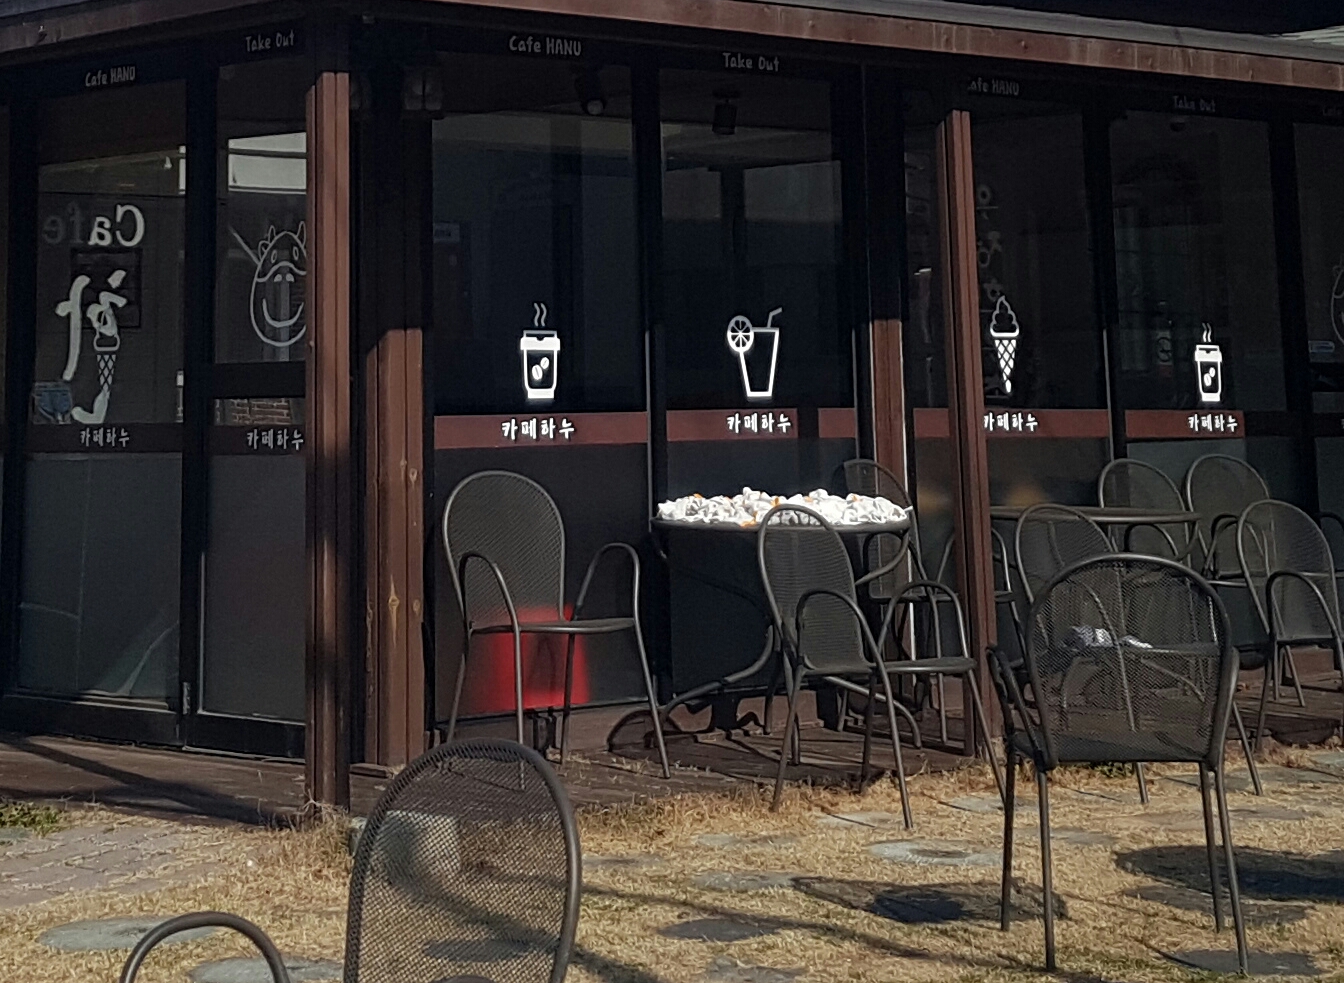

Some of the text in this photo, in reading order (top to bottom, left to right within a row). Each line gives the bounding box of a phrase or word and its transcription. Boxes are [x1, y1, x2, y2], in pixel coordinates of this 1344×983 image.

[246, 28, 295, 52] Take Out
[509, 35, 582, 57] Cafe HANU
[722, 52, 781, 72] Take Out
[501, 417, 576, 441] 카페하누
[726, 412, 792, 434] 카페하누
[983, 412, 1039, 433] 카페하누
[1187, 413, 1239, 433] 카페하누
[80, 427, 130, 449] 카페하누
[247, 427, 305, 451] 카페하누
